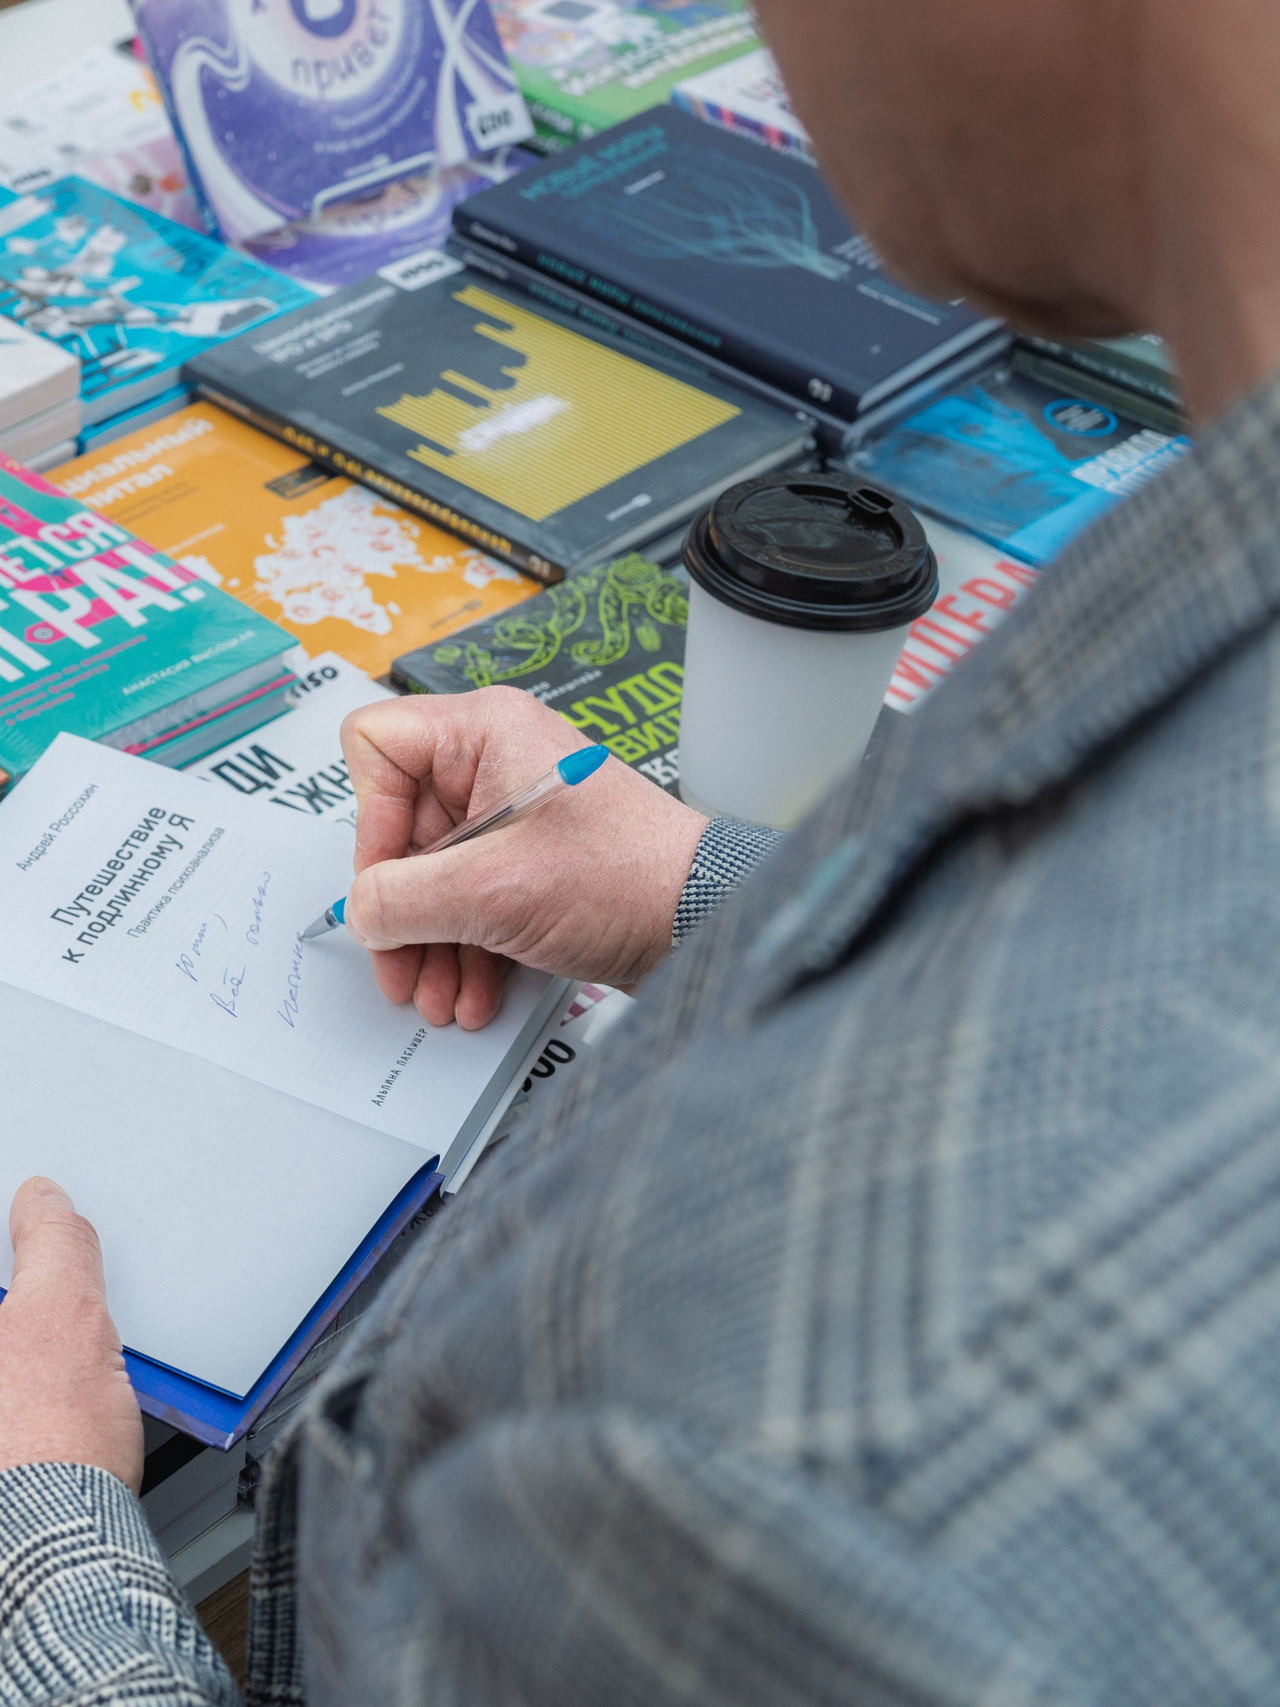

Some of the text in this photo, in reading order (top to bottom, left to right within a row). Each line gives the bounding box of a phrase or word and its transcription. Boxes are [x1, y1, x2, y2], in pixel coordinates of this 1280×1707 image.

[56, 416, 214, 495] циальный
[81, 464, 173, 508] питал
[121, 658, 189, 697] АНАСТАСИЯ
[16, 783, 99, 872] Андрей Россохин
[50, 804, 168, 926] Путешествие
[61, 813, 197, 965] к подлинному Я
[126, 826, 227, 939] Практика психоанализа
